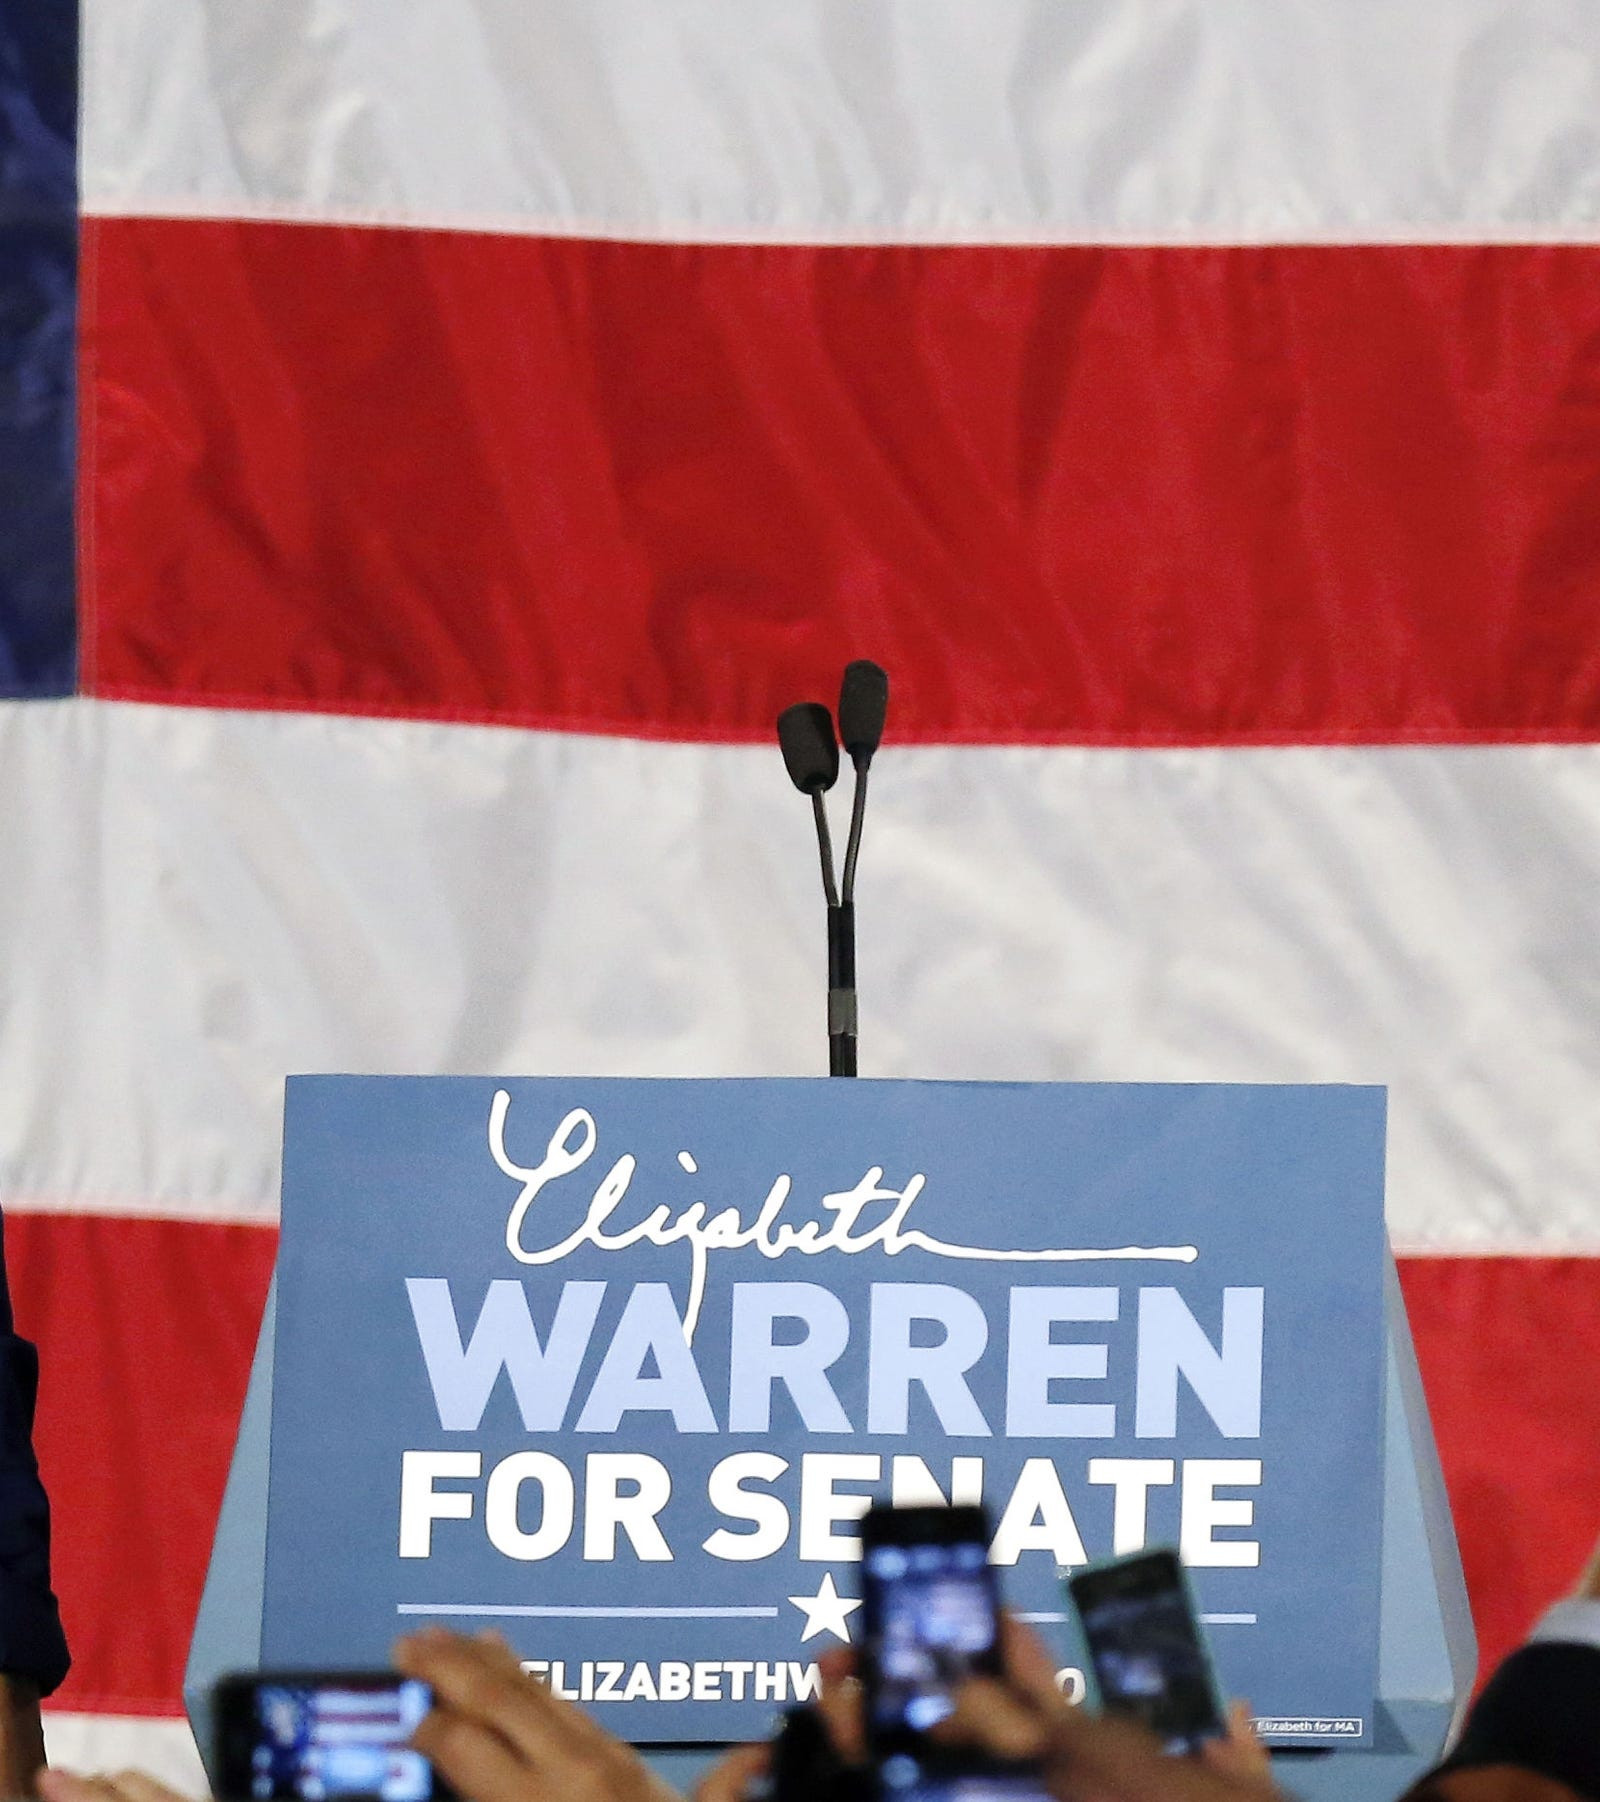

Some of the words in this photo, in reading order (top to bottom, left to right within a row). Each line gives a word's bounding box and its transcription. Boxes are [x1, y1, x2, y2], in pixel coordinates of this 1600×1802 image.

[487, 1088, 1199, 1349] Elizabeth
[405, 1276, 1265, 1440] WARREN
[398, 1450, 674, 1562] FOR
[1314, 1721, 1332, 1733] for
